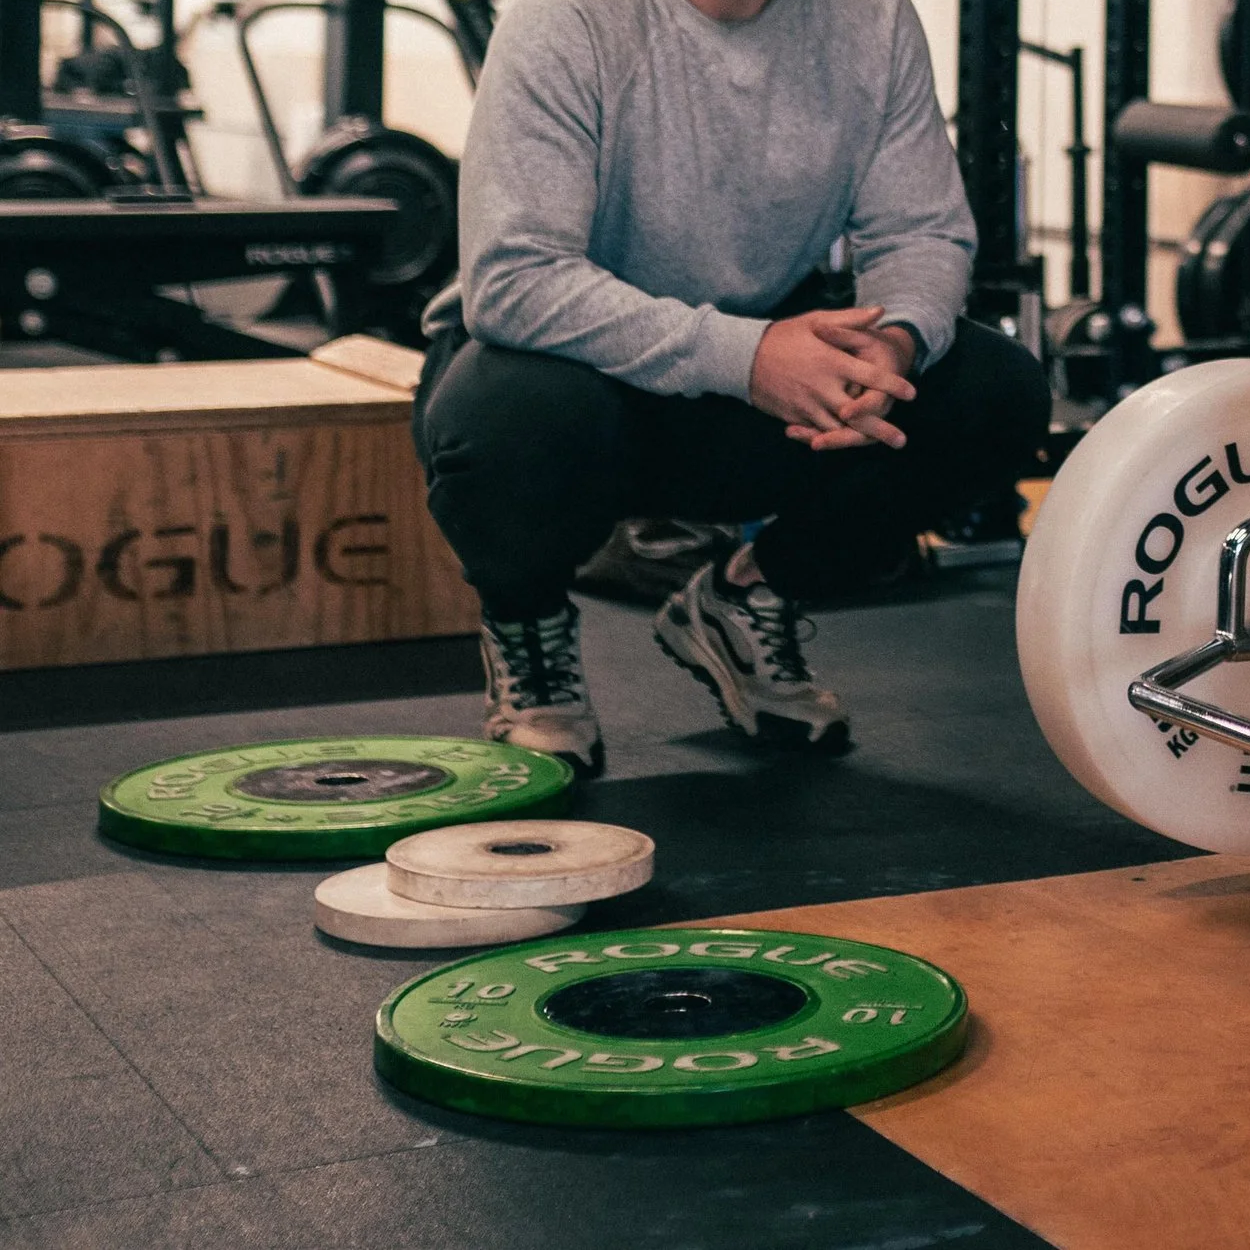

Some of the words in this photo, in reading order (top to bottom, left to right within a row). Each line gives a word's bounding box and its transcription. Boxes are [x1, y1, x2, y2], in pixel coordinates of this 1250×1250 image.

[0, 514, 390, 613] OGUE
[1166, 726, 1199, 760] KG
[523, 942, 888, 976] ROGUE
[447, 981, 517, 1000] 10
[841, 1007, 908, 1026] 10
[441, 1029, 841, 1075] ROGUE
